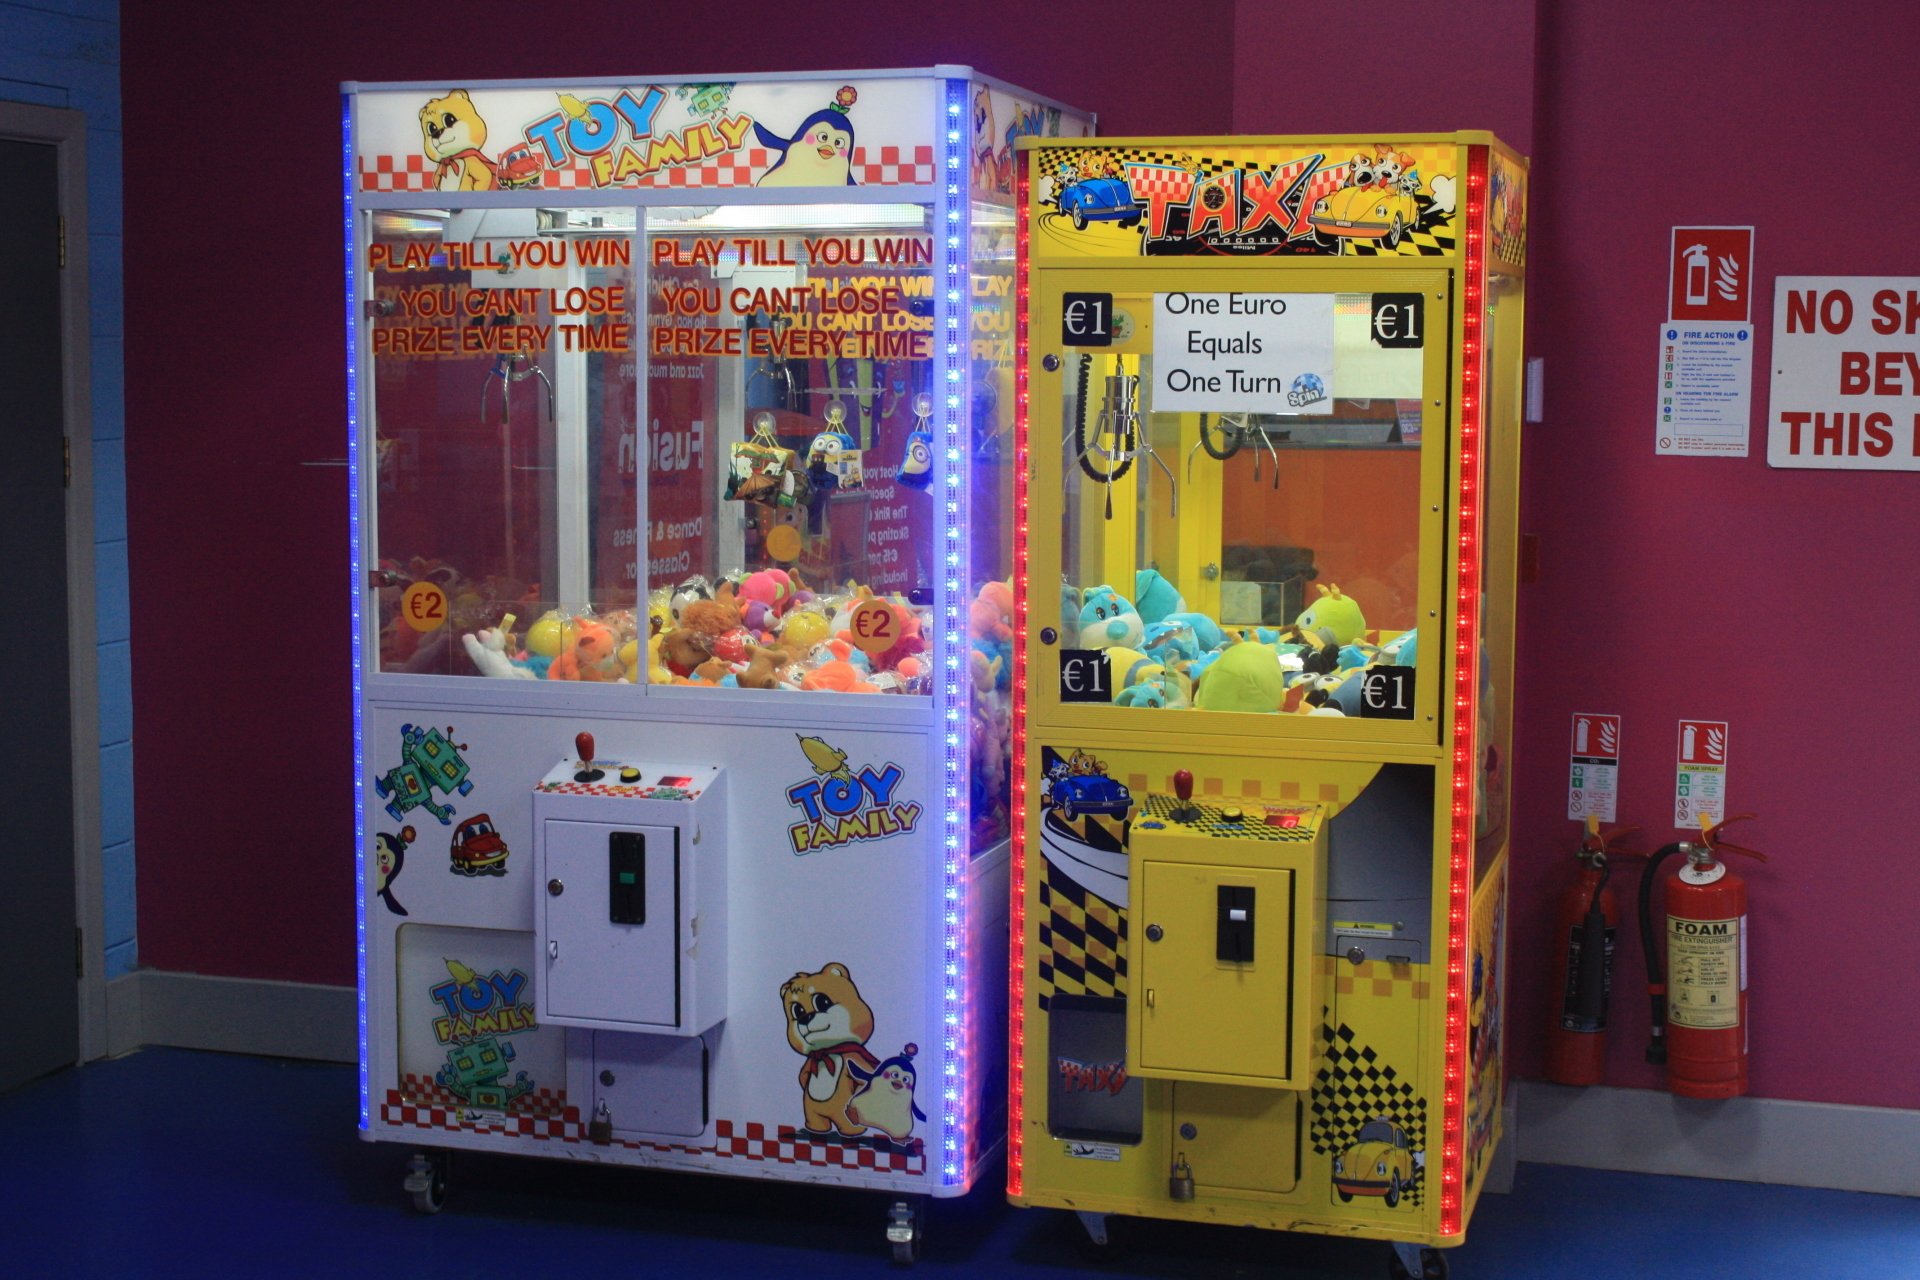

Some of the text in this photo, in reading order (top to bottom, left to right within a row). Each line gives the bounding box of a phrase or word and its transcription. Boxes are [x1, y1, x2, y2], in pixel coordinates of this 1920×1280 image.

[525, 85, 668, 168] TOY
[589, 114, 752, 188] FAMILY
[1124, 153, 1351, 242] TAXI
[368, 239, 630, 271] PLAY TILL YOU WIN
[653, 238, 724, 267] PLAY
[731, 238, 795, 266] TILL
[804, 238, 865, 266] YOU
[874, 237, 933, 266] WIN
[401, 289, 456, 317] YOU
[465, 288, 541, 316] CANT
[550, 286, 625, 314] LOSE
[662, 287, 901, 315] YOU CANT LOSE
[970, 275, 1012, 297] LAY
[1063, 300, 1108, 336] €1
[1165, 292, 1287, 315] One Euro
[1786, 289, 1853, 335] NO
[817, 312, 877, 331] CANT
[1374, 304, 1420, 339] €1
[1683, 331, 1735, 339] FIRE ACTION
[371, 326, 454, 354] PRIZE
[462, 325, 551, 353] EVERY
[558, 324, 629, 352] TIME
[654, 327, 741, 356] PRIZE
[750, 328, 847, 357] EVERY
[855, 330, 928, 358] TIME
[1187, 330, 1263, 361] Equals
[1166, 368, 1281, 393] One Turn
[1781, 411, 1894, 458] THIS
[411, 591, 443, 620] €2
[855, 609, 891, 638] €2
[1062, 657, 1104, 694] €1
[1362, 674, 1407, 711] €1
[788, 765, 902, 824] TOY
[790, 803, 920, 853] FAMILY
[1675, 921, 1728, 936] FOAM
[431, 972, 526, 1019] TOY
[434, 1006, 537, 1042] FAMILY
